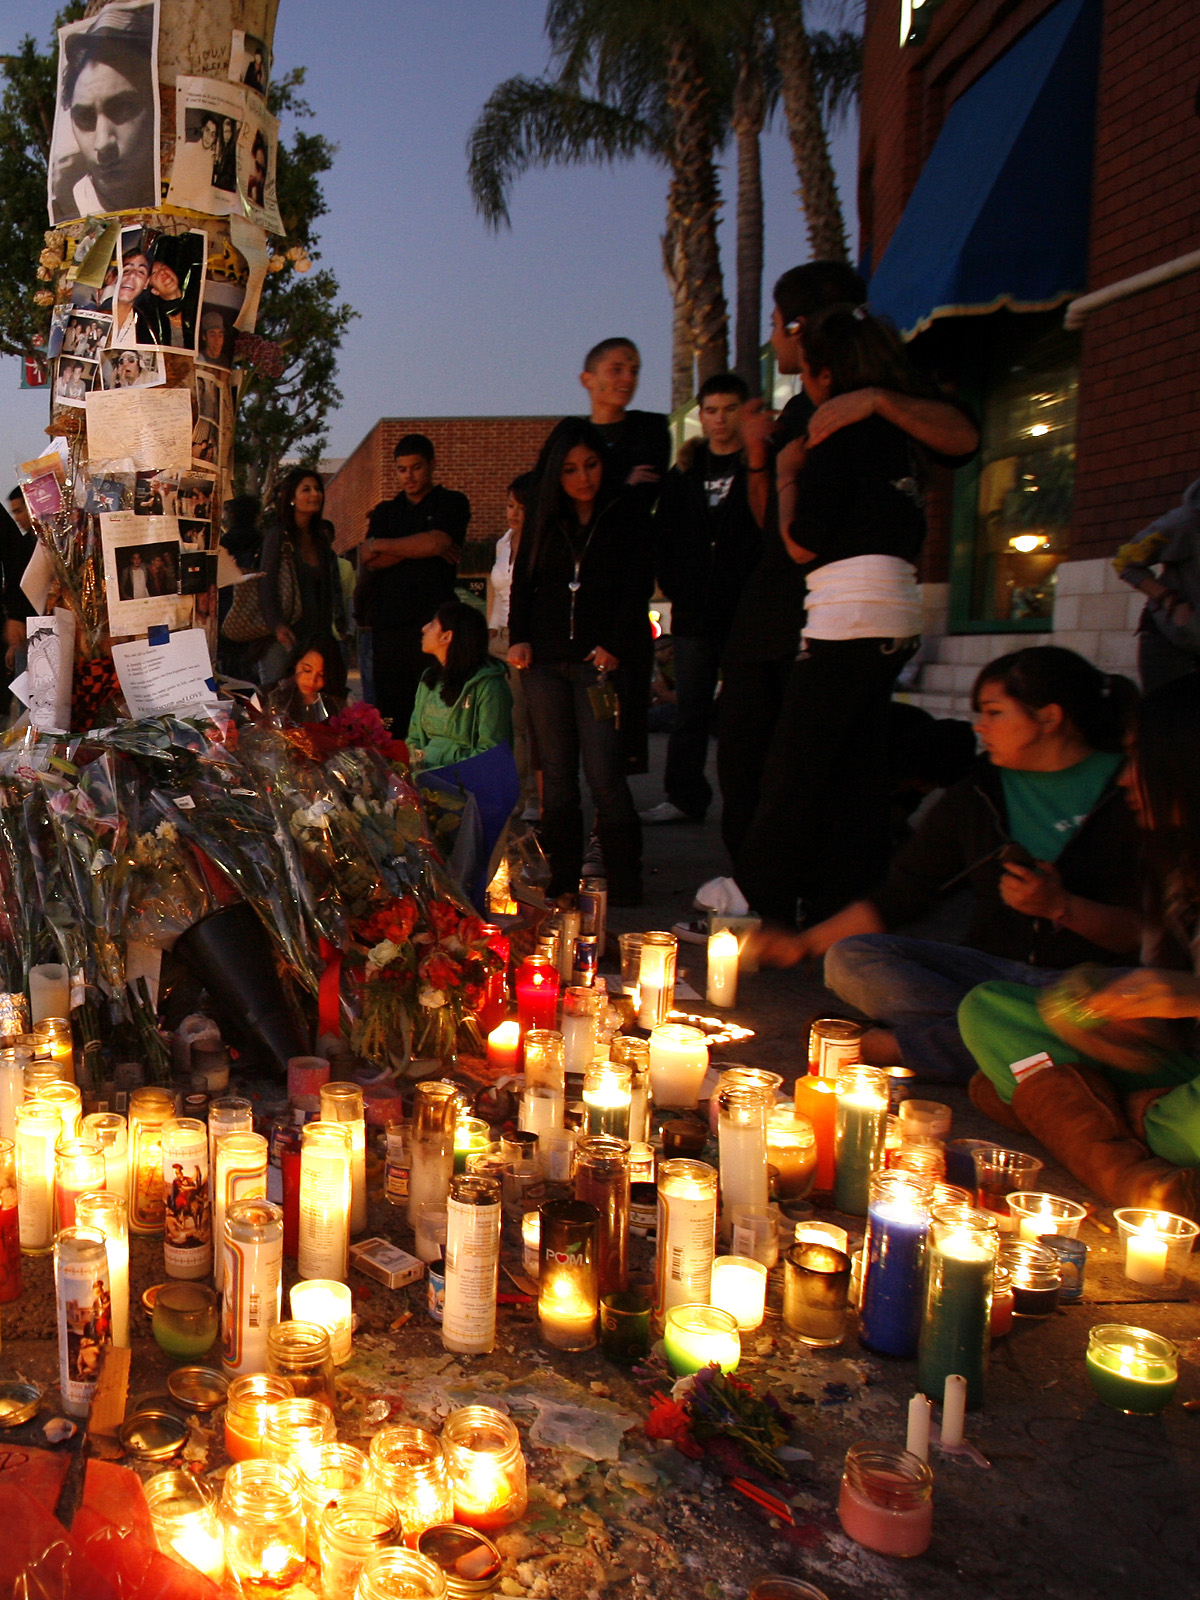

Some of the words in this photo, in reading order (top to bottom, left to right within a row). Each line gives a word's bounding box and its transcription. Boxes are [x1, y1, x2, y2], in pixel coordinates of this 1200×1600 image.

[469, 582, 485, 590] 350
[185, 691, 203, 702] LOVE
[545, 1248, 584, 1267] POM
